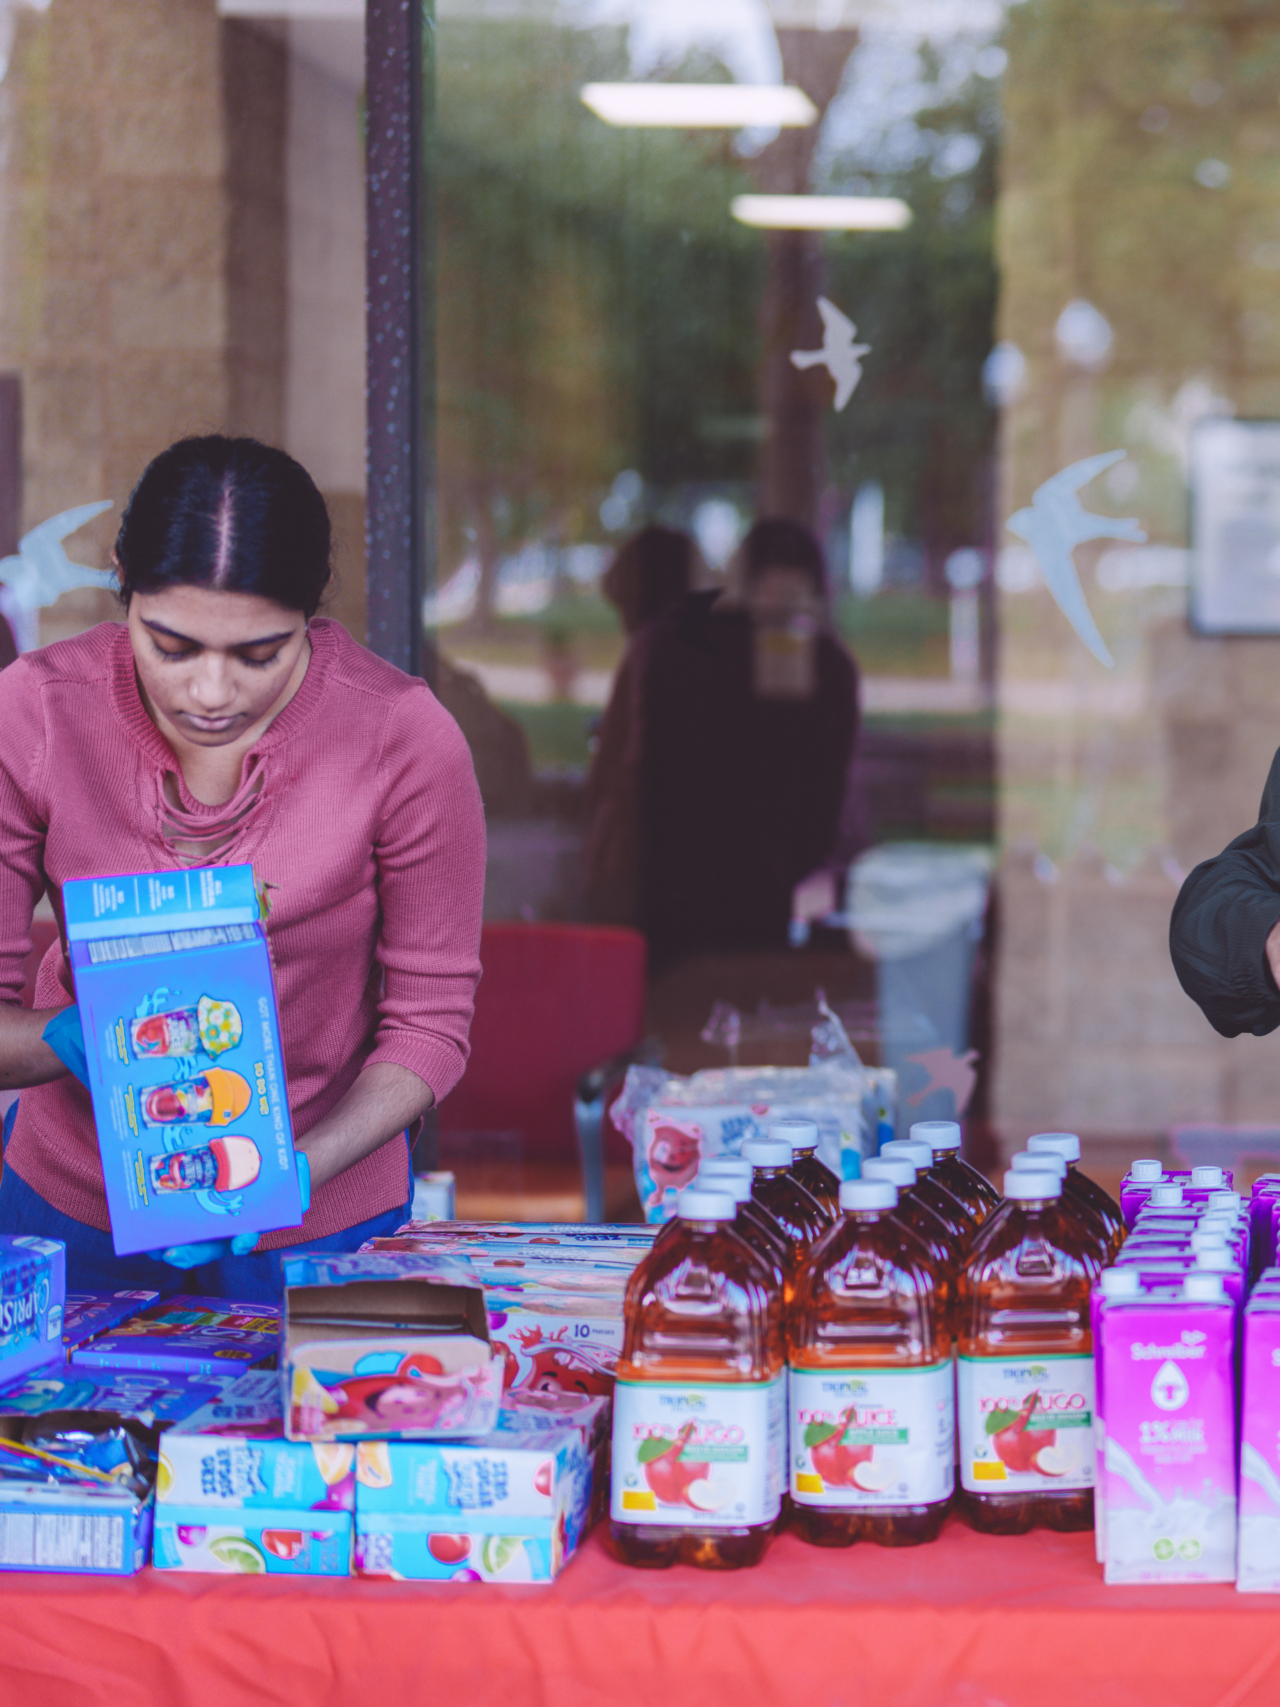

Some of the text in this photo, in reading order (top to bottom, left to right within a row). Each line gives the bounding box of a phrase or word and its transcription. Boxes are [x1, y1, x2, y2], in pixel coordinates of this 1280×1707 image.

[258, 997, 268, 1018] GOT
[261, 1021, 272, 1051] MORE
[254, 1062, 264, 1077] SO
[265, 1053, 276, 1080] THAN
[269, 1083, 279, 1104] ONE
[272, 1106, 283, 1130] KIND
[275, 1132, 284, 1146] OF
[574, 1324, 590, 1338] 10
[979, 1396, 1018, 1413] 100%
[797, 1408, 834, 1425] 100%
[632, 1423, 673, 1441] 100%
[1139, 1420, 1169, 1444] 1%
